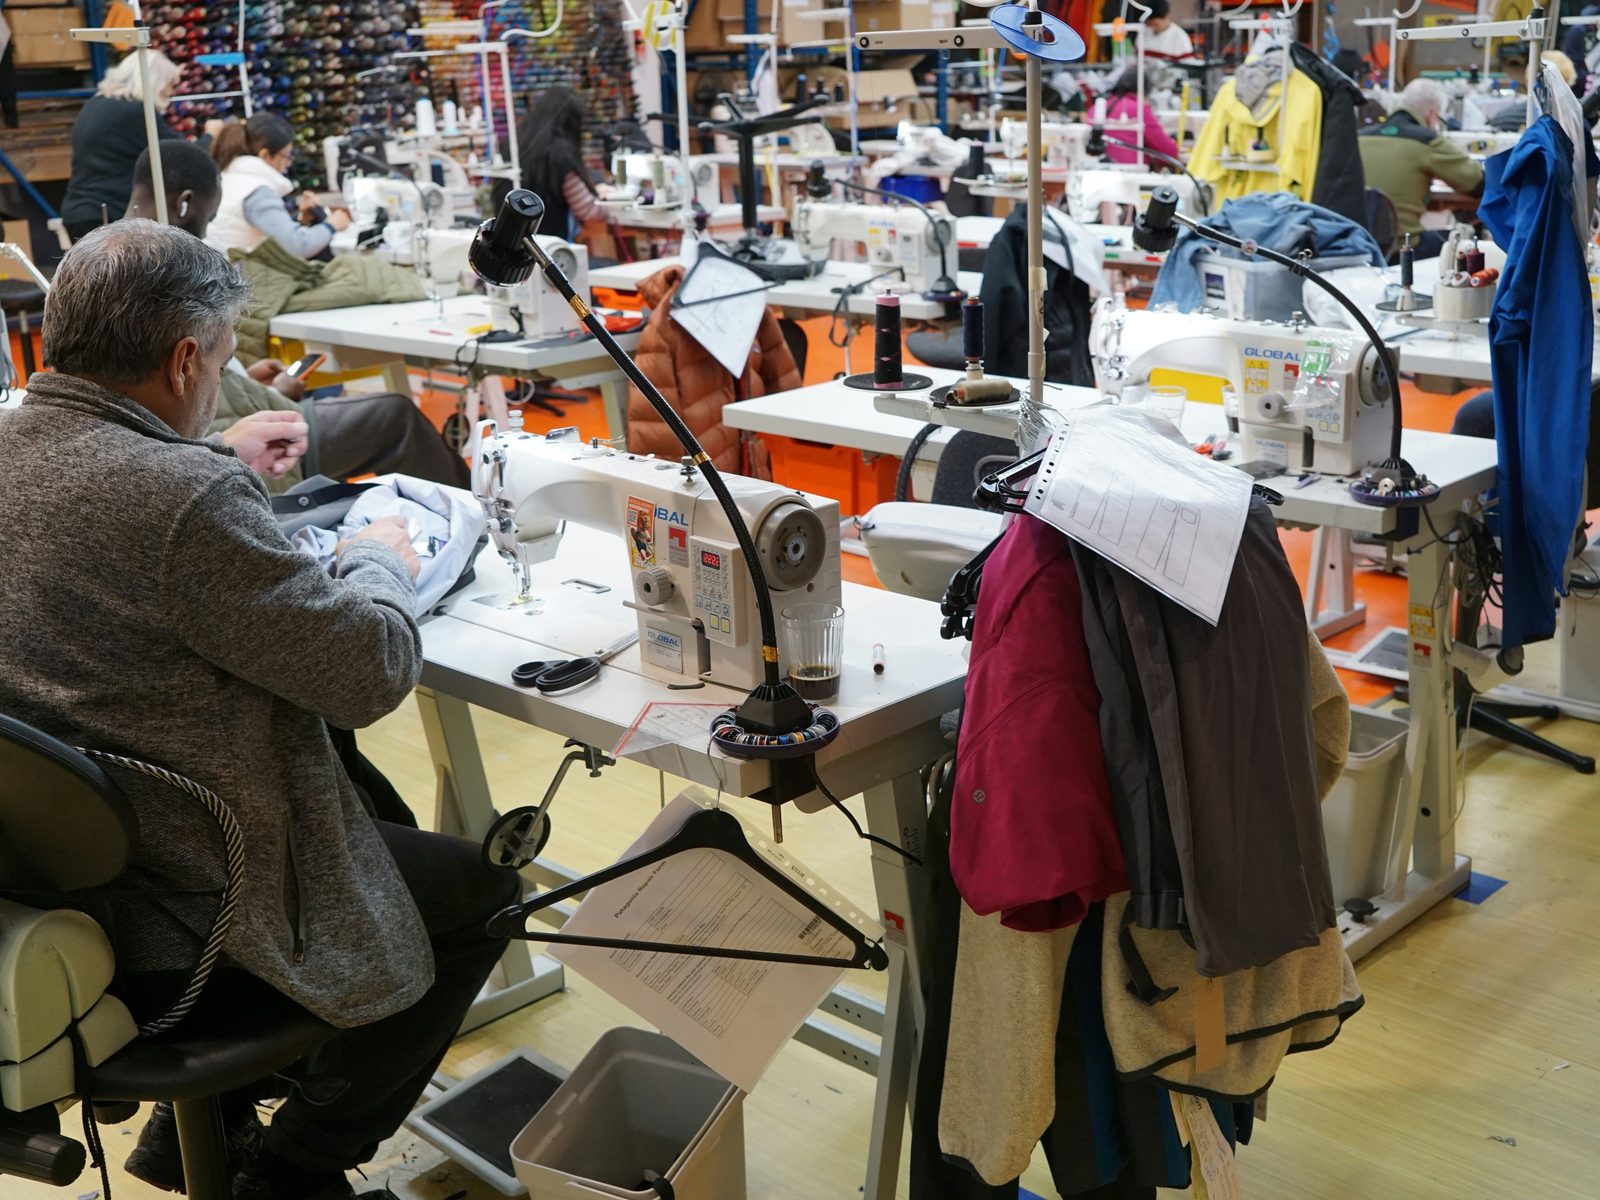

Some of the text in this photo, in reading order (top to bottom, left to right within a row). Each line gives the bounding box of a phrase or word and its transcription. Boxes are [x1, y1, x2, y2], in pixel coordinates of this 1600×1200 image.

[1245, 347, 1301, 362] GLOBAL
[654, 505, 689, 527] BAL
[647, 631, 679, 647] GLOBAL
[614, 892, 639, 919] Patagonia
[638, 875, 654, 892] Repair
